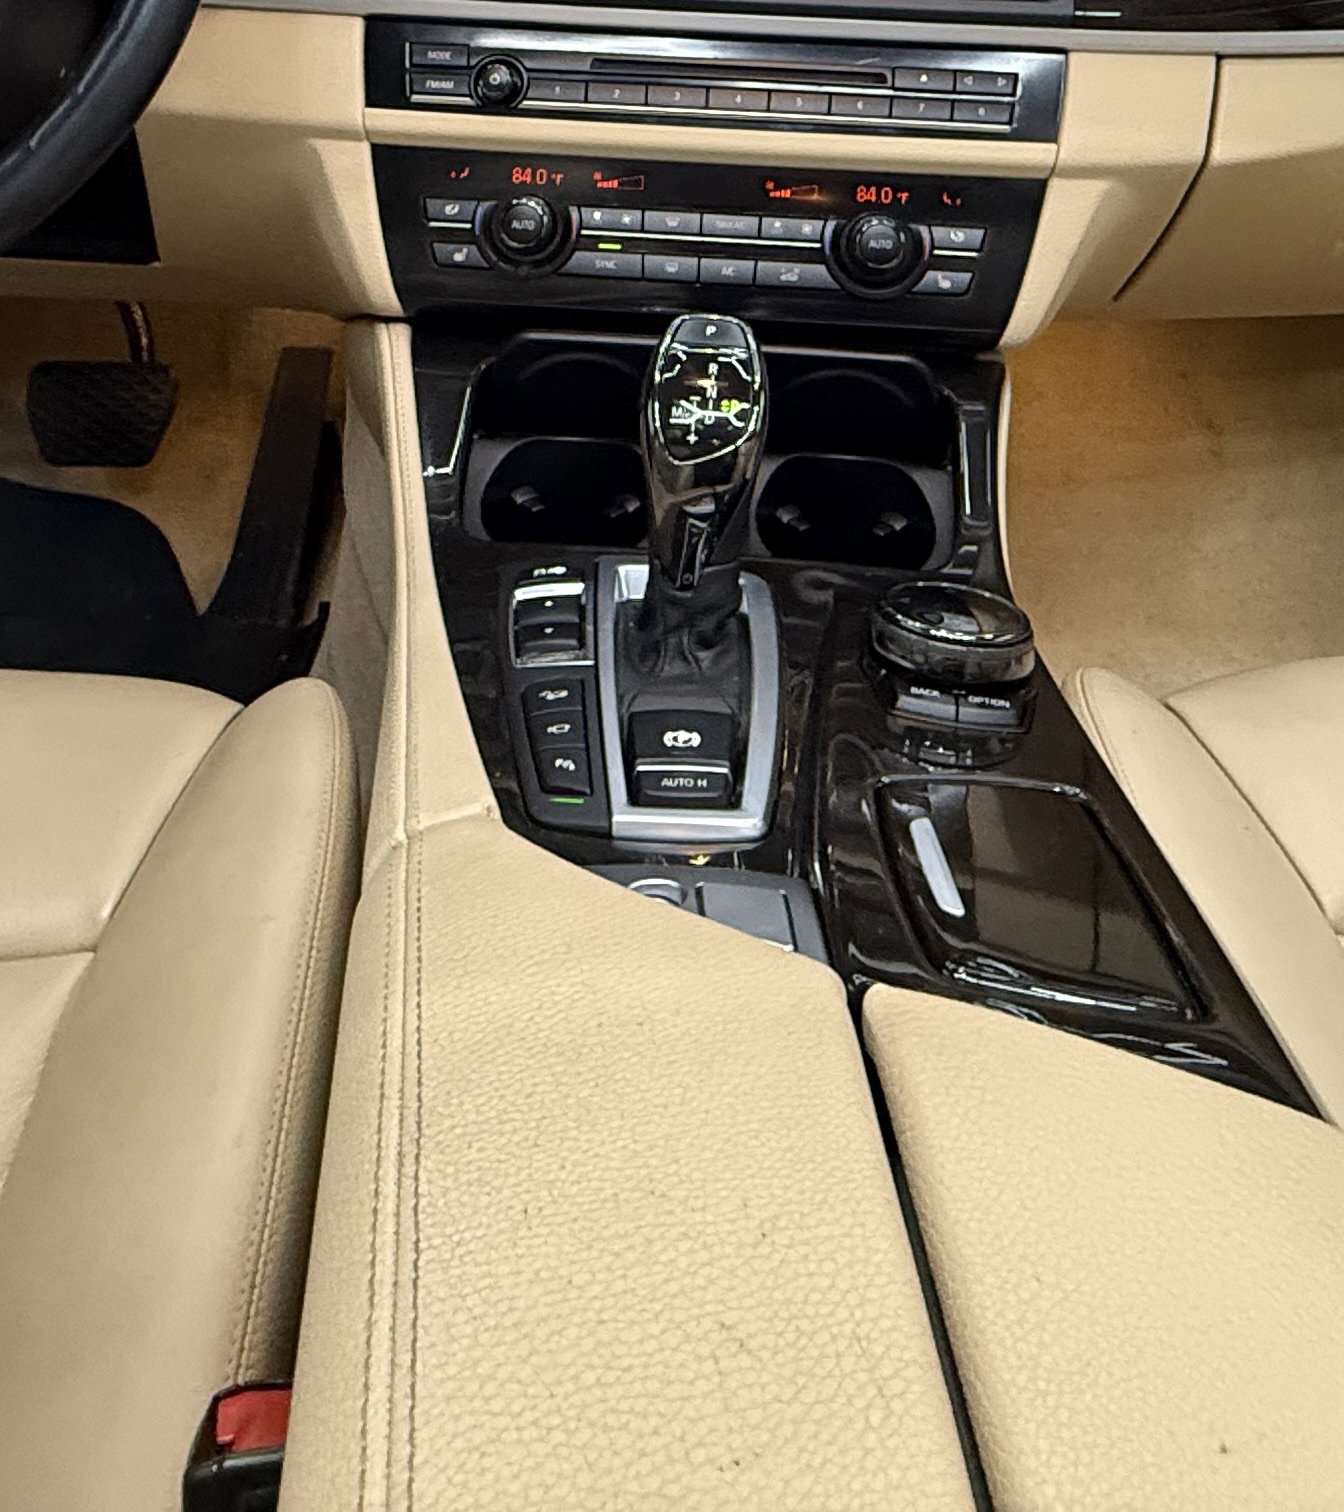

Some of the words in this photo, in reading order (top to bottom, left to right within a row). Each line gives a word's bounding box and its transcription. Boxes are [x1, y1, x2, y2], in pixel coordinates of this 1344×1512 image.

[511, 219, 536, 231] AUTO
[868, 238, 893, 250] AUTO
[706, 325, 717, 337] P
[708, 362, 719, 376] R
[968, 695, 1010, 709] OPTION
[661, 778, 694, 788] AUTO
[697, 779, 707, 788] H
